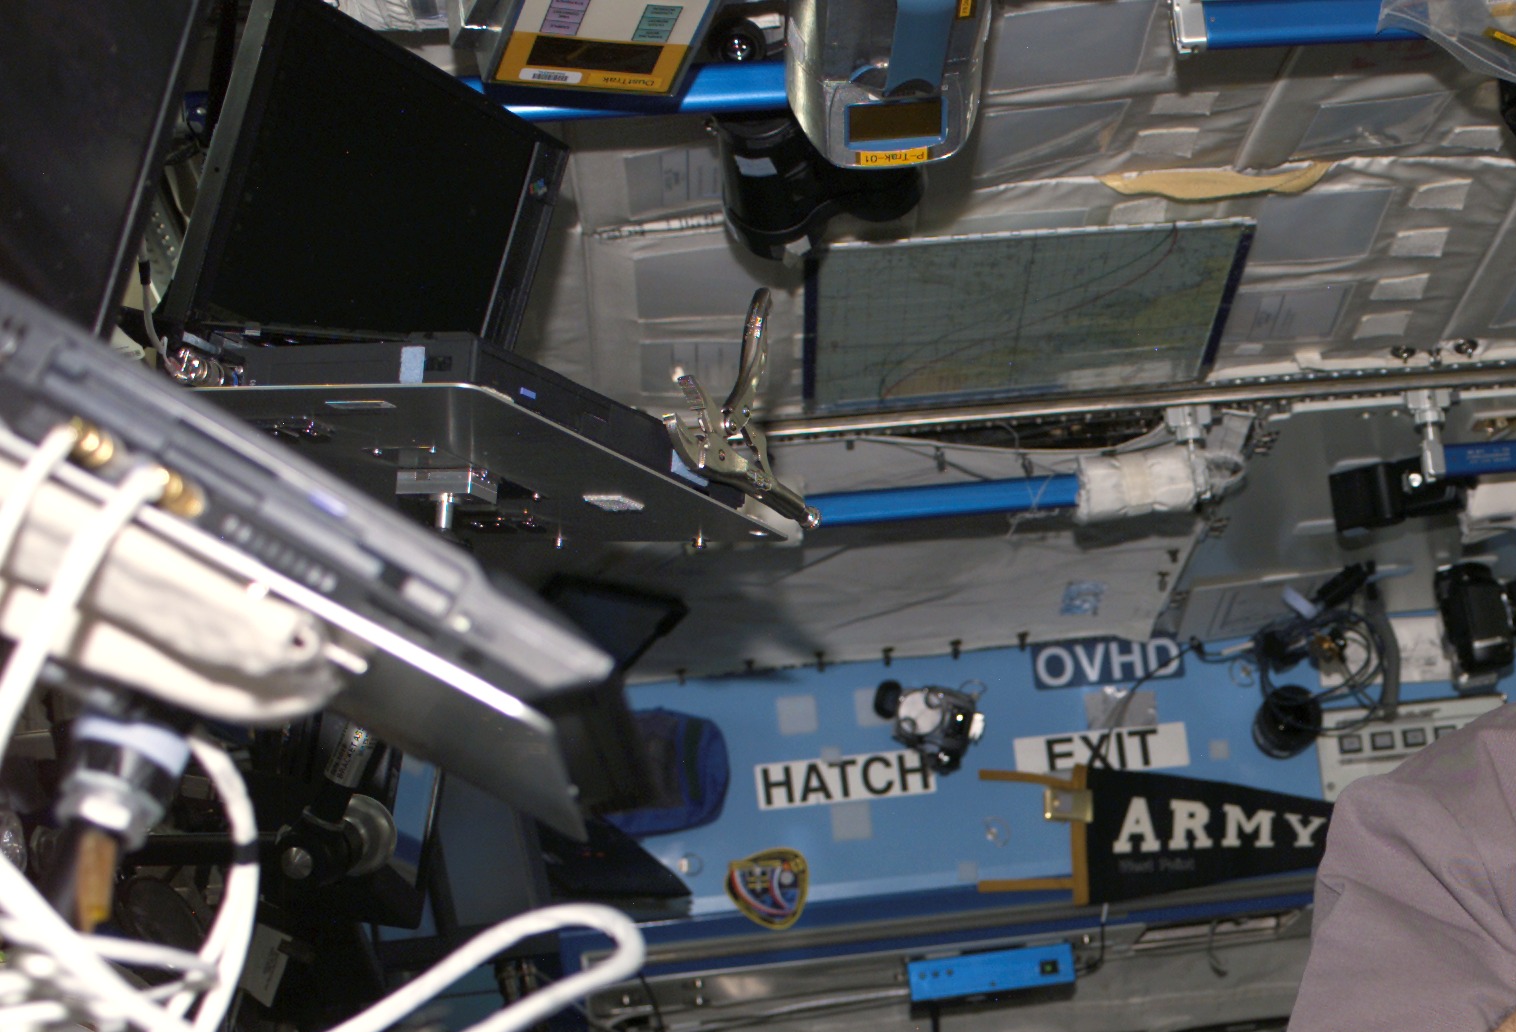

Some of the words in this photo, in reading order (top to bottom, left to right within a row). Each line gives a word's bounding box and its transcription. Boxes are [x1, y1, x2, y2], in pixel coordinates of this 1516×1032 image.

[601, 76, 655, 88] DustTrak
[864, 151, 925, 164] P-Trak-01
[1035, 639, 1182, 687] OVHD
[760, 753, 933, 807] HATCH
[1113, 795, 1327, 855] ARMY
